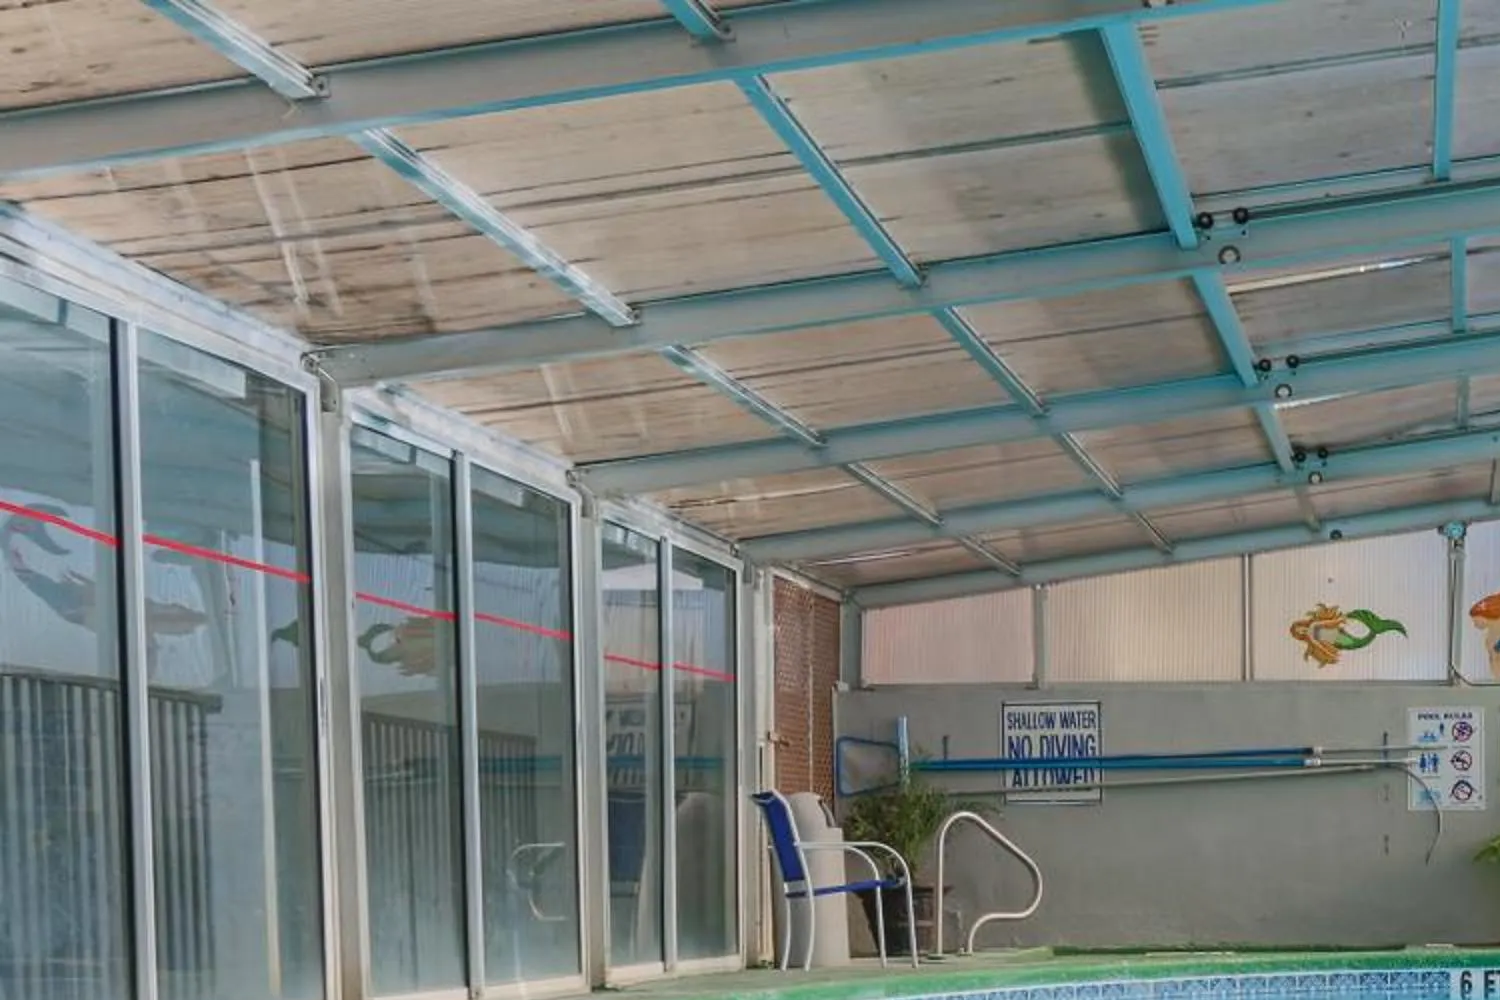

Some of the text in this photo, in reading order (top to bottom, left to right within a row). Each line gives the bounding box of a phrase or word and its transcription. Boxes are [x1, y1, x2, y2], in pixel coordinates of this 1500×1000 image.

[1006, 710, 1096, 729] SHALLOW WATER
[1007, 734, 1097, 759] NO DIVING
